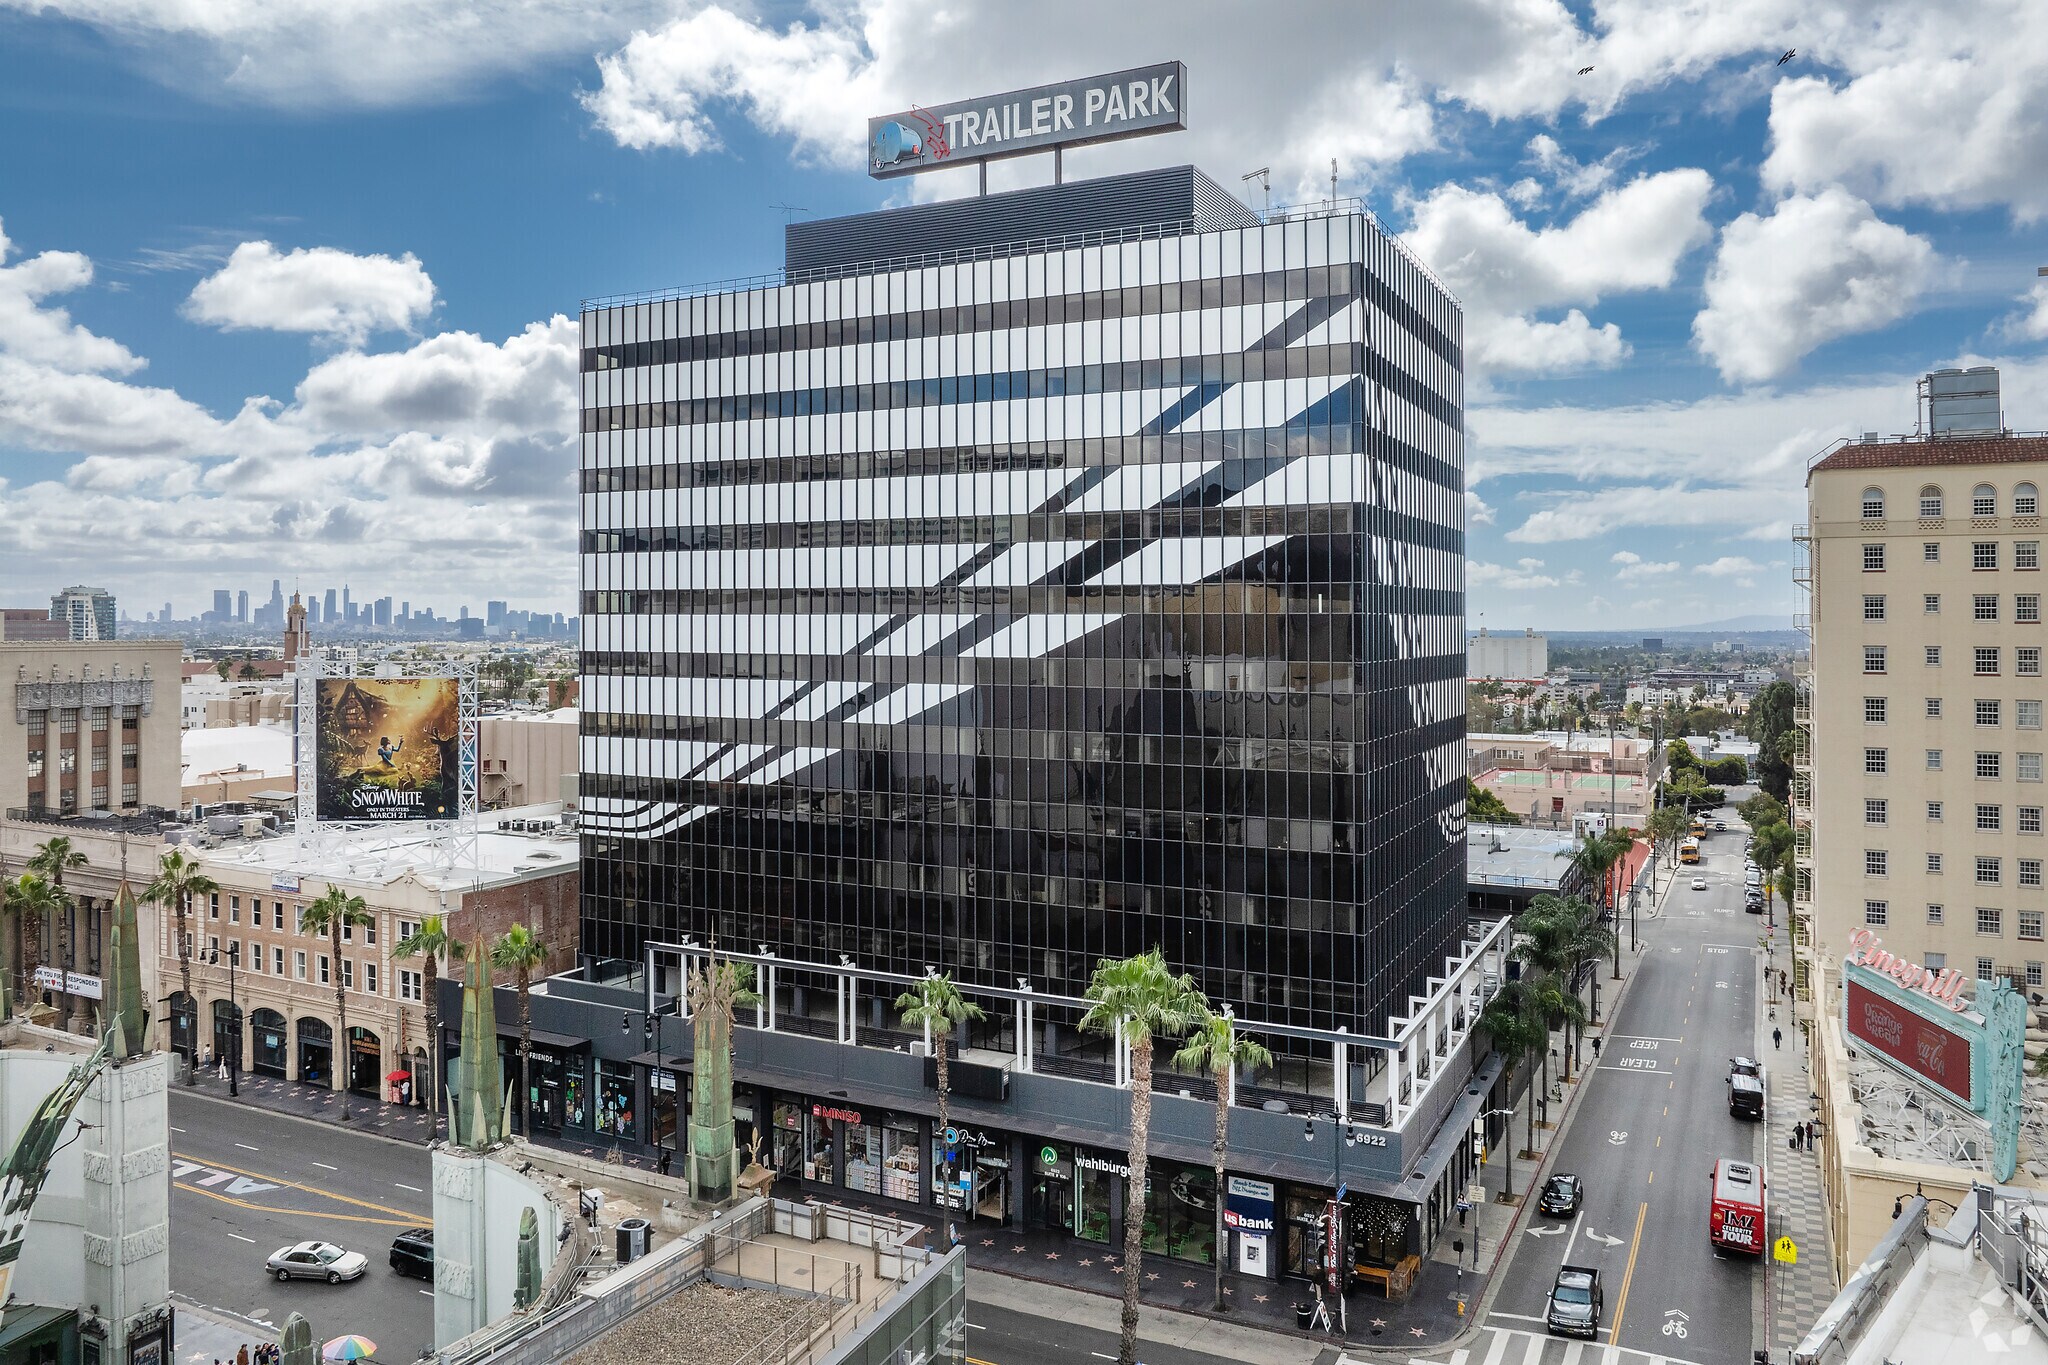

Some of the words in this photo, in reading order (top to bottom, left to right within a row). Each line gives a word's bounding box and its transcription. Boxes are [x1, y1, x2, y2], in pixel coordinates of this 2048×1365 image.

[944, 94, 1075, 150] TRAILER
[1085, 74, 1175, 127] PARK
[1849, 927, 1970, 1012] Cinegrill
[1630, 1040, 1659, 1050] KEEP
[529, 1051, 553, 1062] FRIENDS
[1620, 1058, 1657, 1069] CLEAR
[822, 1106, 861, 1124] MINISO
[1356, 1132, 1386, 1147] 6922
[1076, 1157, 1132, 1177] wahlburge
[936, 1198, 959, 1208] DOUTS
[1719, 1208, 1757, 1230] TMZ
[1721, 1230, 1753, 1245] TOUR
[1722, 1224, 1752, 1236] CELEBRITY
